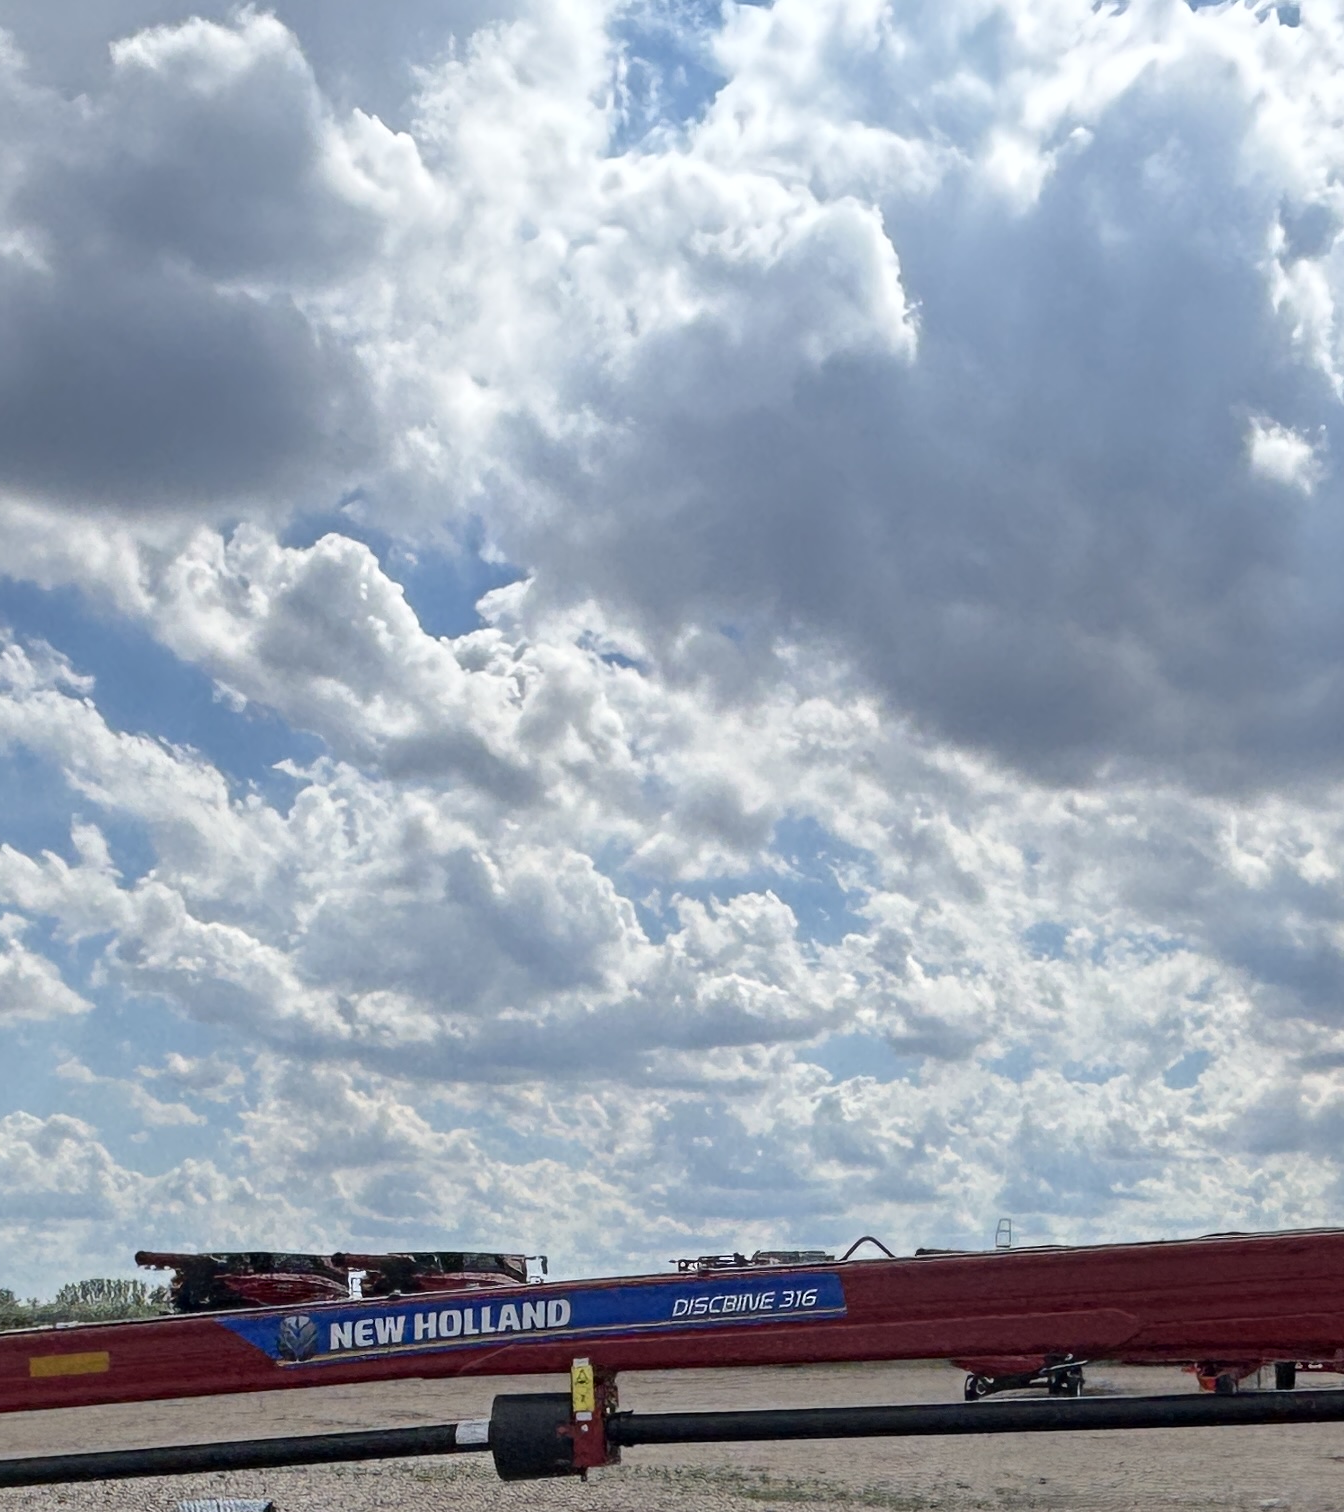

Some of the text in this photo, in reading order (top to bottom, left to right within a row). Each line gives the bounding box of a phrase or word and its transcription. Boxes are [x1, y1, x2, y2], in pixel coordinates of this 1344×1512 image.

[672, 1288, 818, 1318] DISCBINE 316
[330, 1299, 572, 1350] NEW HOLLAND
